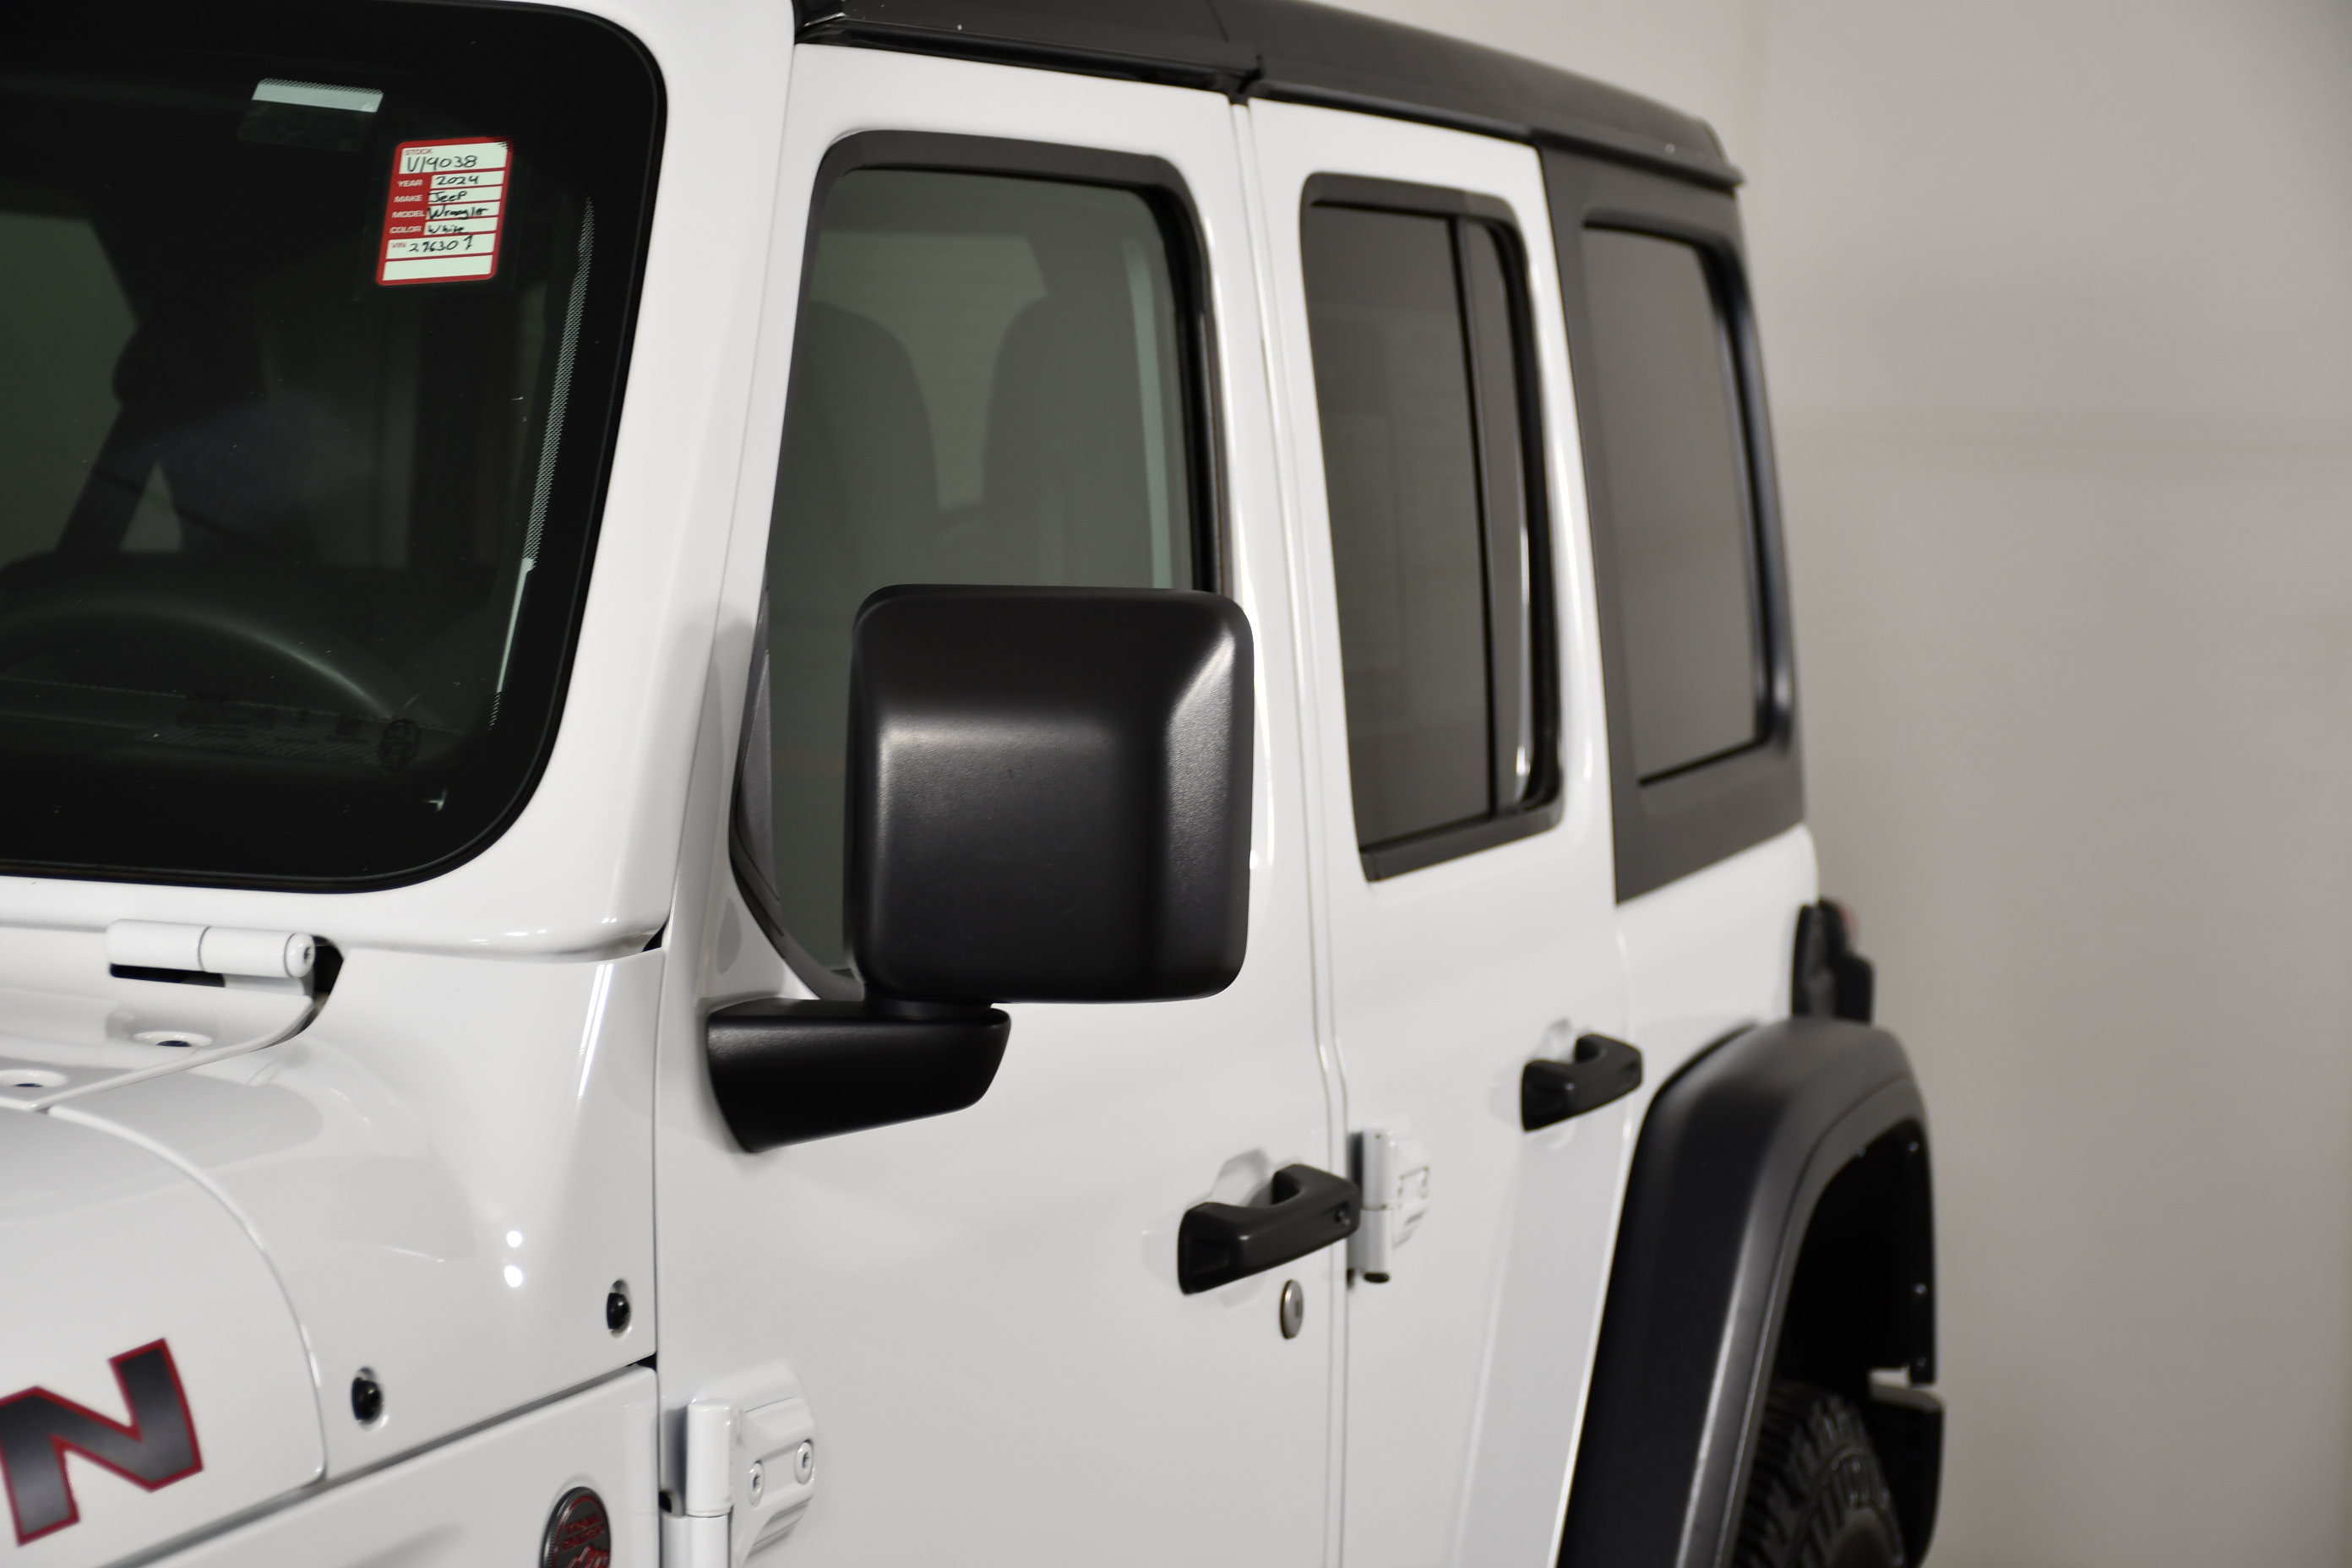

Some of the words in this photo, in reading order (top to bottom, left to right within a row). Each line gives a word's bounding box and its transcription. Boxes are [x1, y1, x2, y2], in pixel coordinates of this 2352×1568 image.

[397, 179, 423, 188] YEAR
[435, 175, 479, 185] 2024
[394, 194, 423, 203] MAKE
[392, 210, 425, 218] MODEL
[427, 204, 489, 220] Wrangler
[428, 223, 468, 234] White
